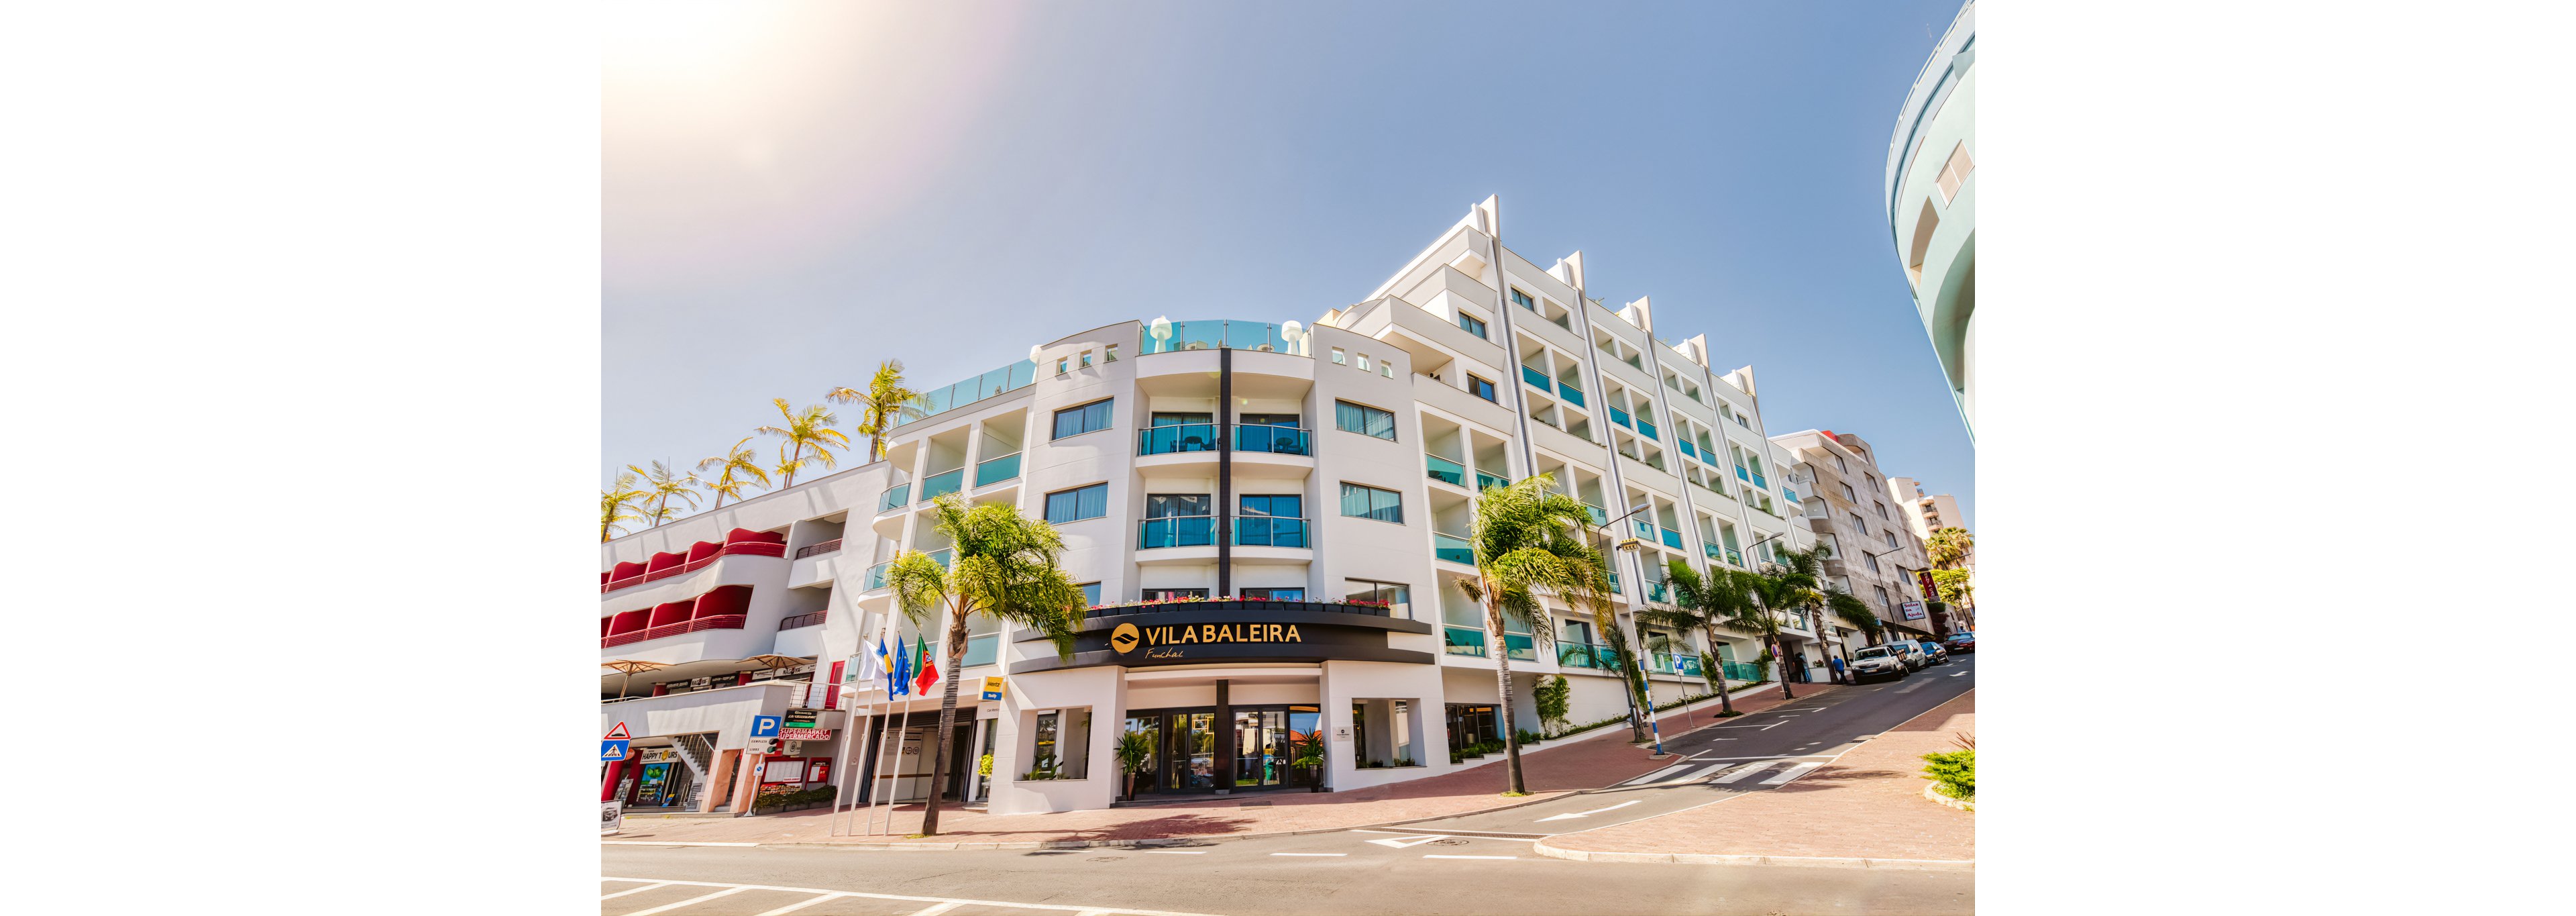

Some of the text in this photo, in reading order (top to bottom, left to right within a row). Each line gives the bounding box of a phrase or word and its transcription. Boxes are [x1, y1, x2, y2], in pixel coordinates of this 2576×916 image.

[1145, 624, 1301, 646] VILA BALEIRA
[1144, 647, 1183, 659] Funchal
[1674, 655, 1680, 667] P
[758, 719, 775, 735] P
